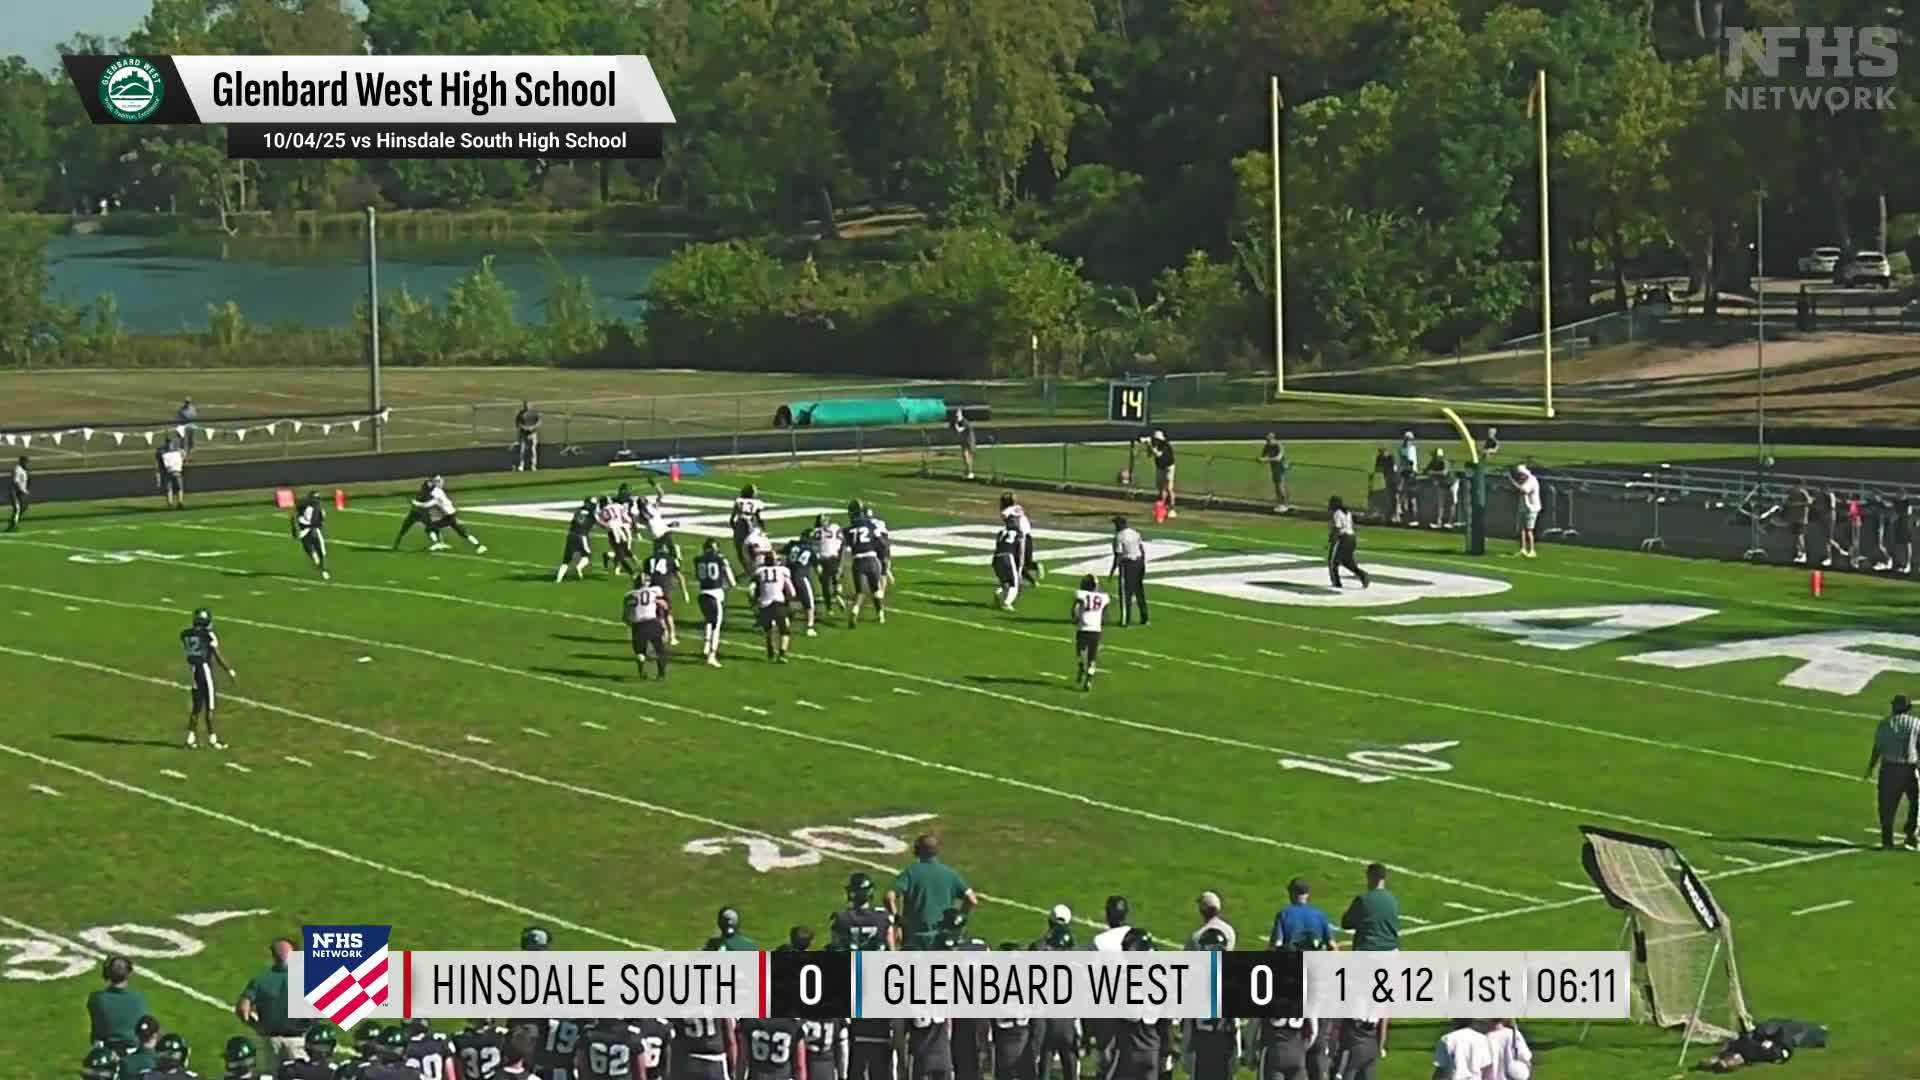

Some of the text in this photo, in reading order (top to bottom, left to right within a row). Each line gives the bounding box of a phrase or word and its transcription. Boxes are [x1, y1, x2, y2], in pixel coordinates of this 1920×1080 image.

[1122, 389, 1143, 418] 14
[849, 527, 872, 544] 72
[650, 557, 667, 575] 14
[762, 567, 777, 583] 11
[1278, 748, 1454, 784] 10
[683, 825, 909, 873] 20
[590, 1043, 630, 1077] 62
[751, 1029, 792, 1063] 63
